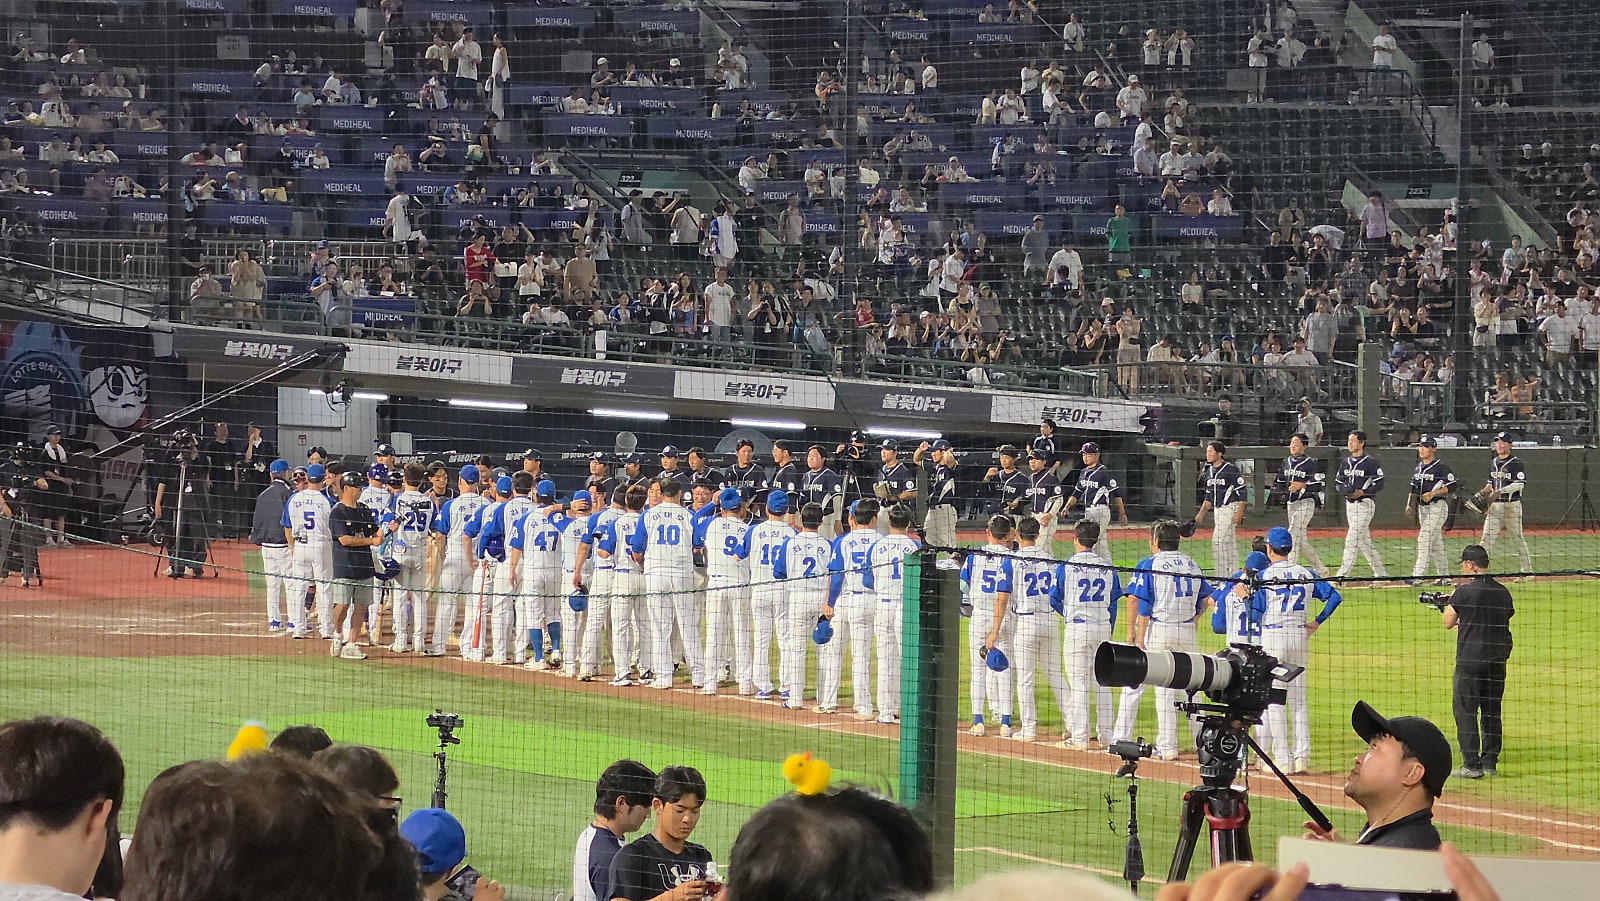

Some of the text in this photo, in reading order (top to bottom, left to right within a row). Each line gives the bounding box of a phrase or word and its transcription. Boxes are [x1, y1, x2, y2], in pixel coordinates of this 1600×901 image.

[295, 6, 333, 15] MEDIHEAL
[431, 12, 468, 22] MEDIHEAL
[535, 17, 572, 26] MEDIHEAL
[641, 22, 678, 31] MEDIHEAL
[891, 31, 929, 41] MEDIHEAL
[976, 34, 1014, 42] MEDIHEAL
[193, 82, 231, 94] MEDIHEAL
[333, 120, 372, 130] MEDIHEAL
[570, 126, 608, 135] MEDIHEAL
[137, 145, 168, 155] MEDIHE
[324, 183, 362, 193] MEDIHEAL
[966, 195, 1003, 204] MEDIHEAL
[38, 210, 78, 220] MEDIHEAL
[132, 212, 168, 222] MEDIHEA
[229, 215, 269, 226] MEDIHEAL
[805, 223, 837, 233] EDIHEAL
[1179, 227, 1219, 238] MEDIHEAL
[224, 340, 295, 360] 불꽃야구
[395, 355, 463, 374] 불꽃야구
[11, 361, 37, 384] LOTTE
[560, 367, 627, 387] 불꽃야구
[725, 382, 789, 400] 불꽃야구
[882, 393, 947, 413] 불꽃야구
[1041, 405, 1103, 424] 불꽃야구
[303, 511, 316, 530] 5
[404, 512, 428, 531] 29
[652, 511, 685, 522] 이대호
[657, 524, 681, 545] 10
[534, 531, 559, 551] 47
[802, 557, 817, 577] 2
[1025, 566, 1052, 597] 23
[1172, 575, 1192, 598] 11
[1078, 578, 1107, 602] 22
[1276, 586, 1306, 612] 72
